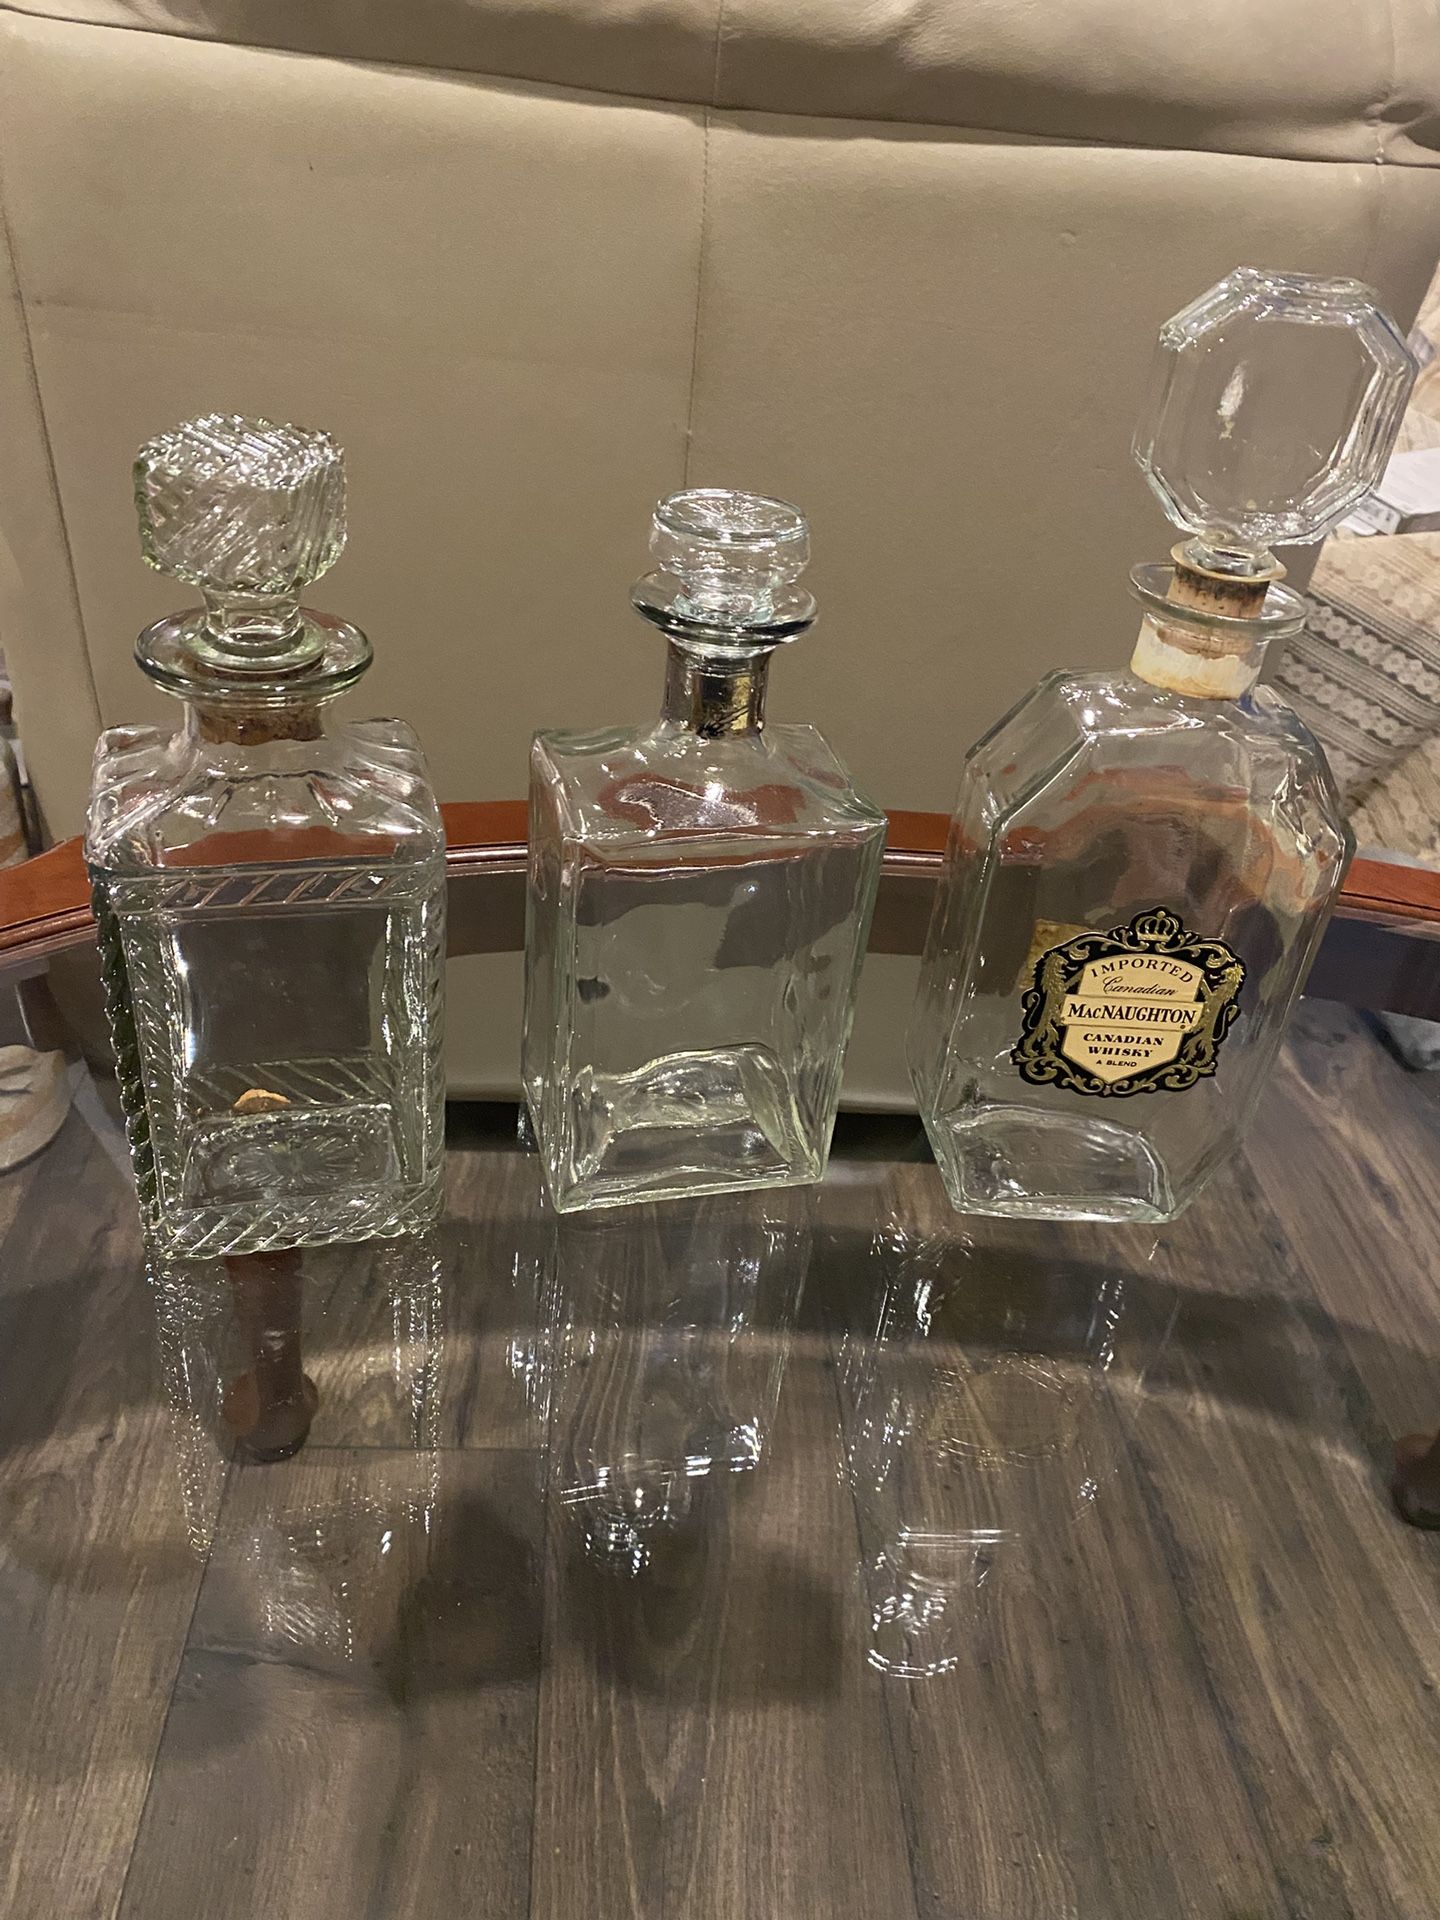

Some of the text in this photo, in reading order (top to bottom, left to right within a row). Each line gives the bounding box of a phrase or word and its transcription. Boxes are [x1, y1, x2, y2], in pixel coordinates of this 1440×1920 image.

[1091, 958, 1193, 983] IMPORTED
[1102, 976, 1178, 997] Canadian
[1083, 1032, 1164, 1047] CANADIAN
[1088, 1046, 1153, 1058] WHISKY
[1106, 1060, 1138, 1068] BLEND
